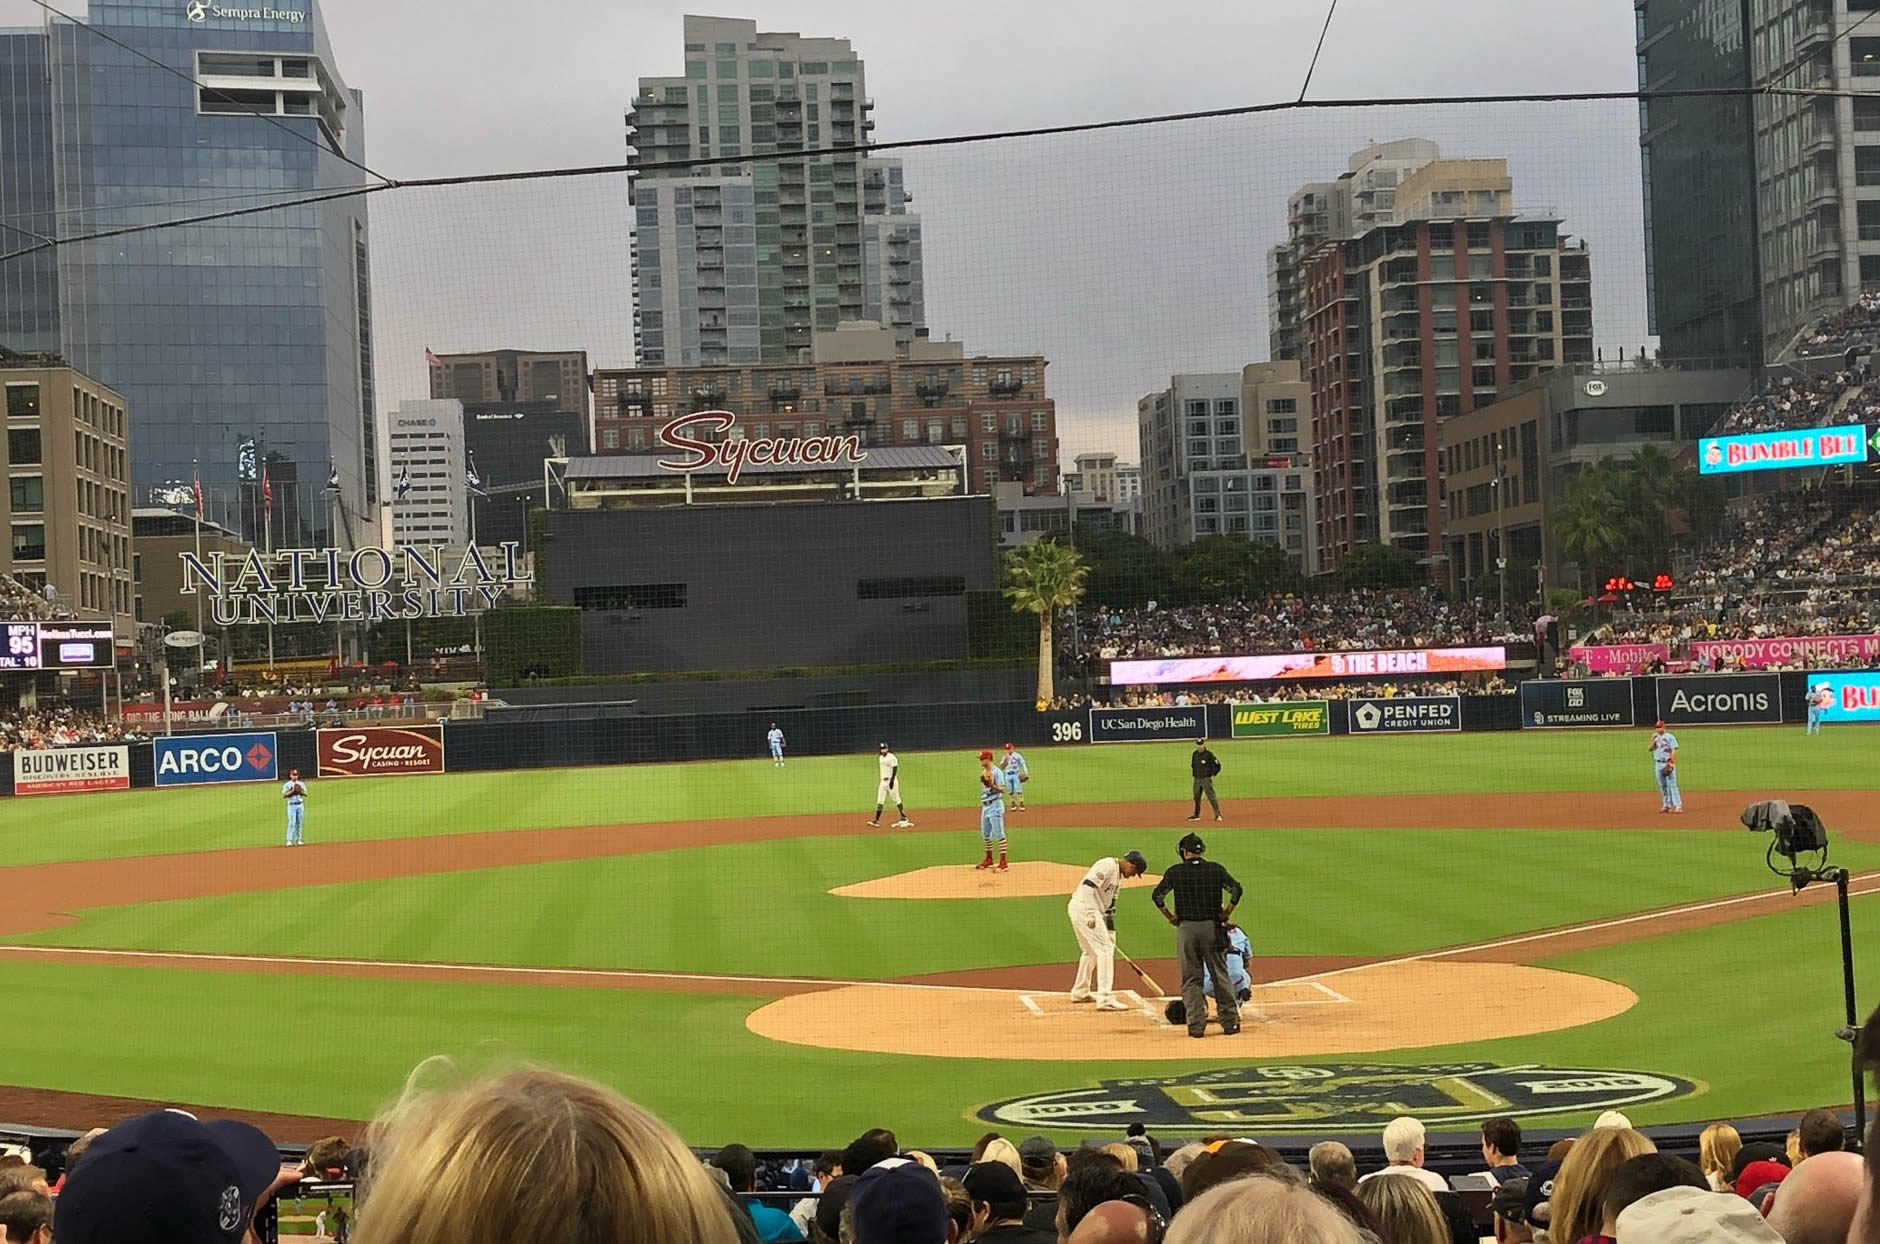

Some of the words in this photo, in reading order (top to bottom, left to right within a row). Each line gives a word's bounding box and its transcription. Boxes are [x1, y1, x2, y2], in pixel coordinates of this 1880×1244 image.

[212, 5, 261, 20] Sempra
[263, 8, 305, 23] Energy
[657, 410, 868, 484] Sycuan
[1727, 438, 1813, 466] BUMBLE
[1819, 435, 1856, 457] BEE
[178, 540, 534, 594] NATIONAL
[208, 585, 507, 625] UNIVERSITY
[8, 625, 35, 636] MPH
[9, 636, 34, 654] 95
[1698, 642, 1766, 661] NOBODY
[1769, 639, 1860, 659] CONNECTS
[24, 656, 37, 667] 10
[1347, 654, 1376, 673] THE
[1377, 651, 1428, 673] BEACH
[1568, 699, 1584, 707] GO
[1670, 690, 1769, 713] Acronis
[1235, 711, 1279, 725] WEST
[1281, 709, 1323, 723] LAKE
[1384, 704, 1451, 719] PENFED
[1547, 714, 1599, 723] STREAMING
[1601, 713, 1620, 721] LIVE
[1052, 721, 1082, 741] 396
[1101, 719, 1117, 730] UC
[1117, 719, 1136, 729] San
[1137, 717, 1164, 731] Diego
[1165, 716, 1196, 728] Health
[1292, 721, 1320, 729] TIRES
[1384, 719, 1418, 727] CREDIT
[1420, 718, 1451, 726] UNION
[159, 746, 243, 775] ARCO
[331, 735, 427, 769] Sycuan
[21, 751, 120, 774] BUDWEISER
[87, 778, 117, 786] LAGER
